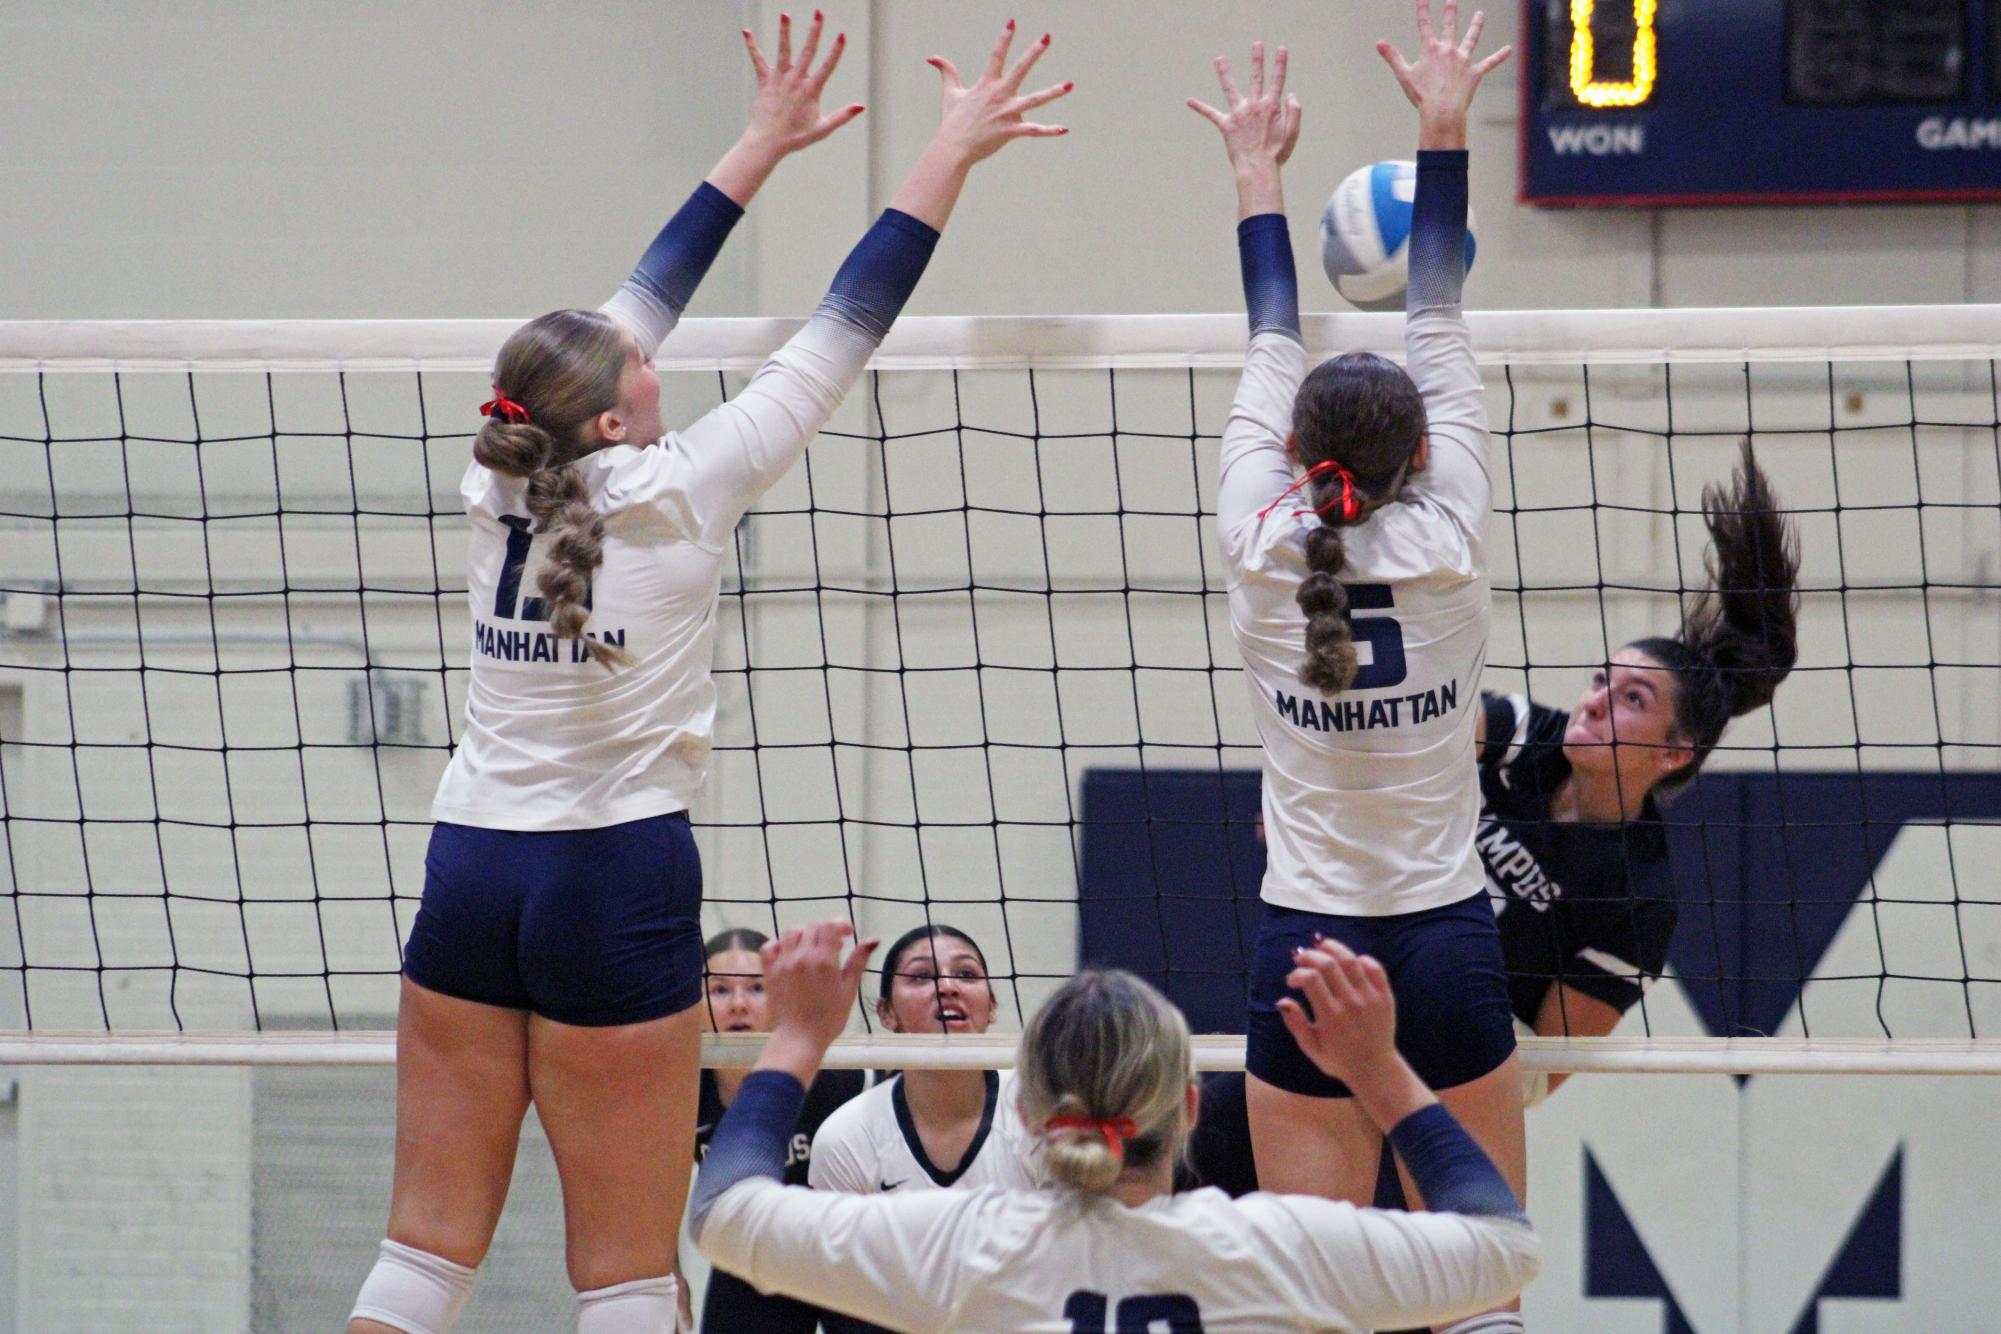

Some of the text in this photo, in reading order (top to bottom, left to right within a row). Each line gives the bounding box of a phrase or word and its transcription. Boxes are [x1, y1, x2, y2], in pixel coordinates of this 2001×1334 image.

[1548, 126, 1643, 154] WON
[1335, 583, 1407, 690] 5
[1276, 678, 1457, 732] MANHATTAN
